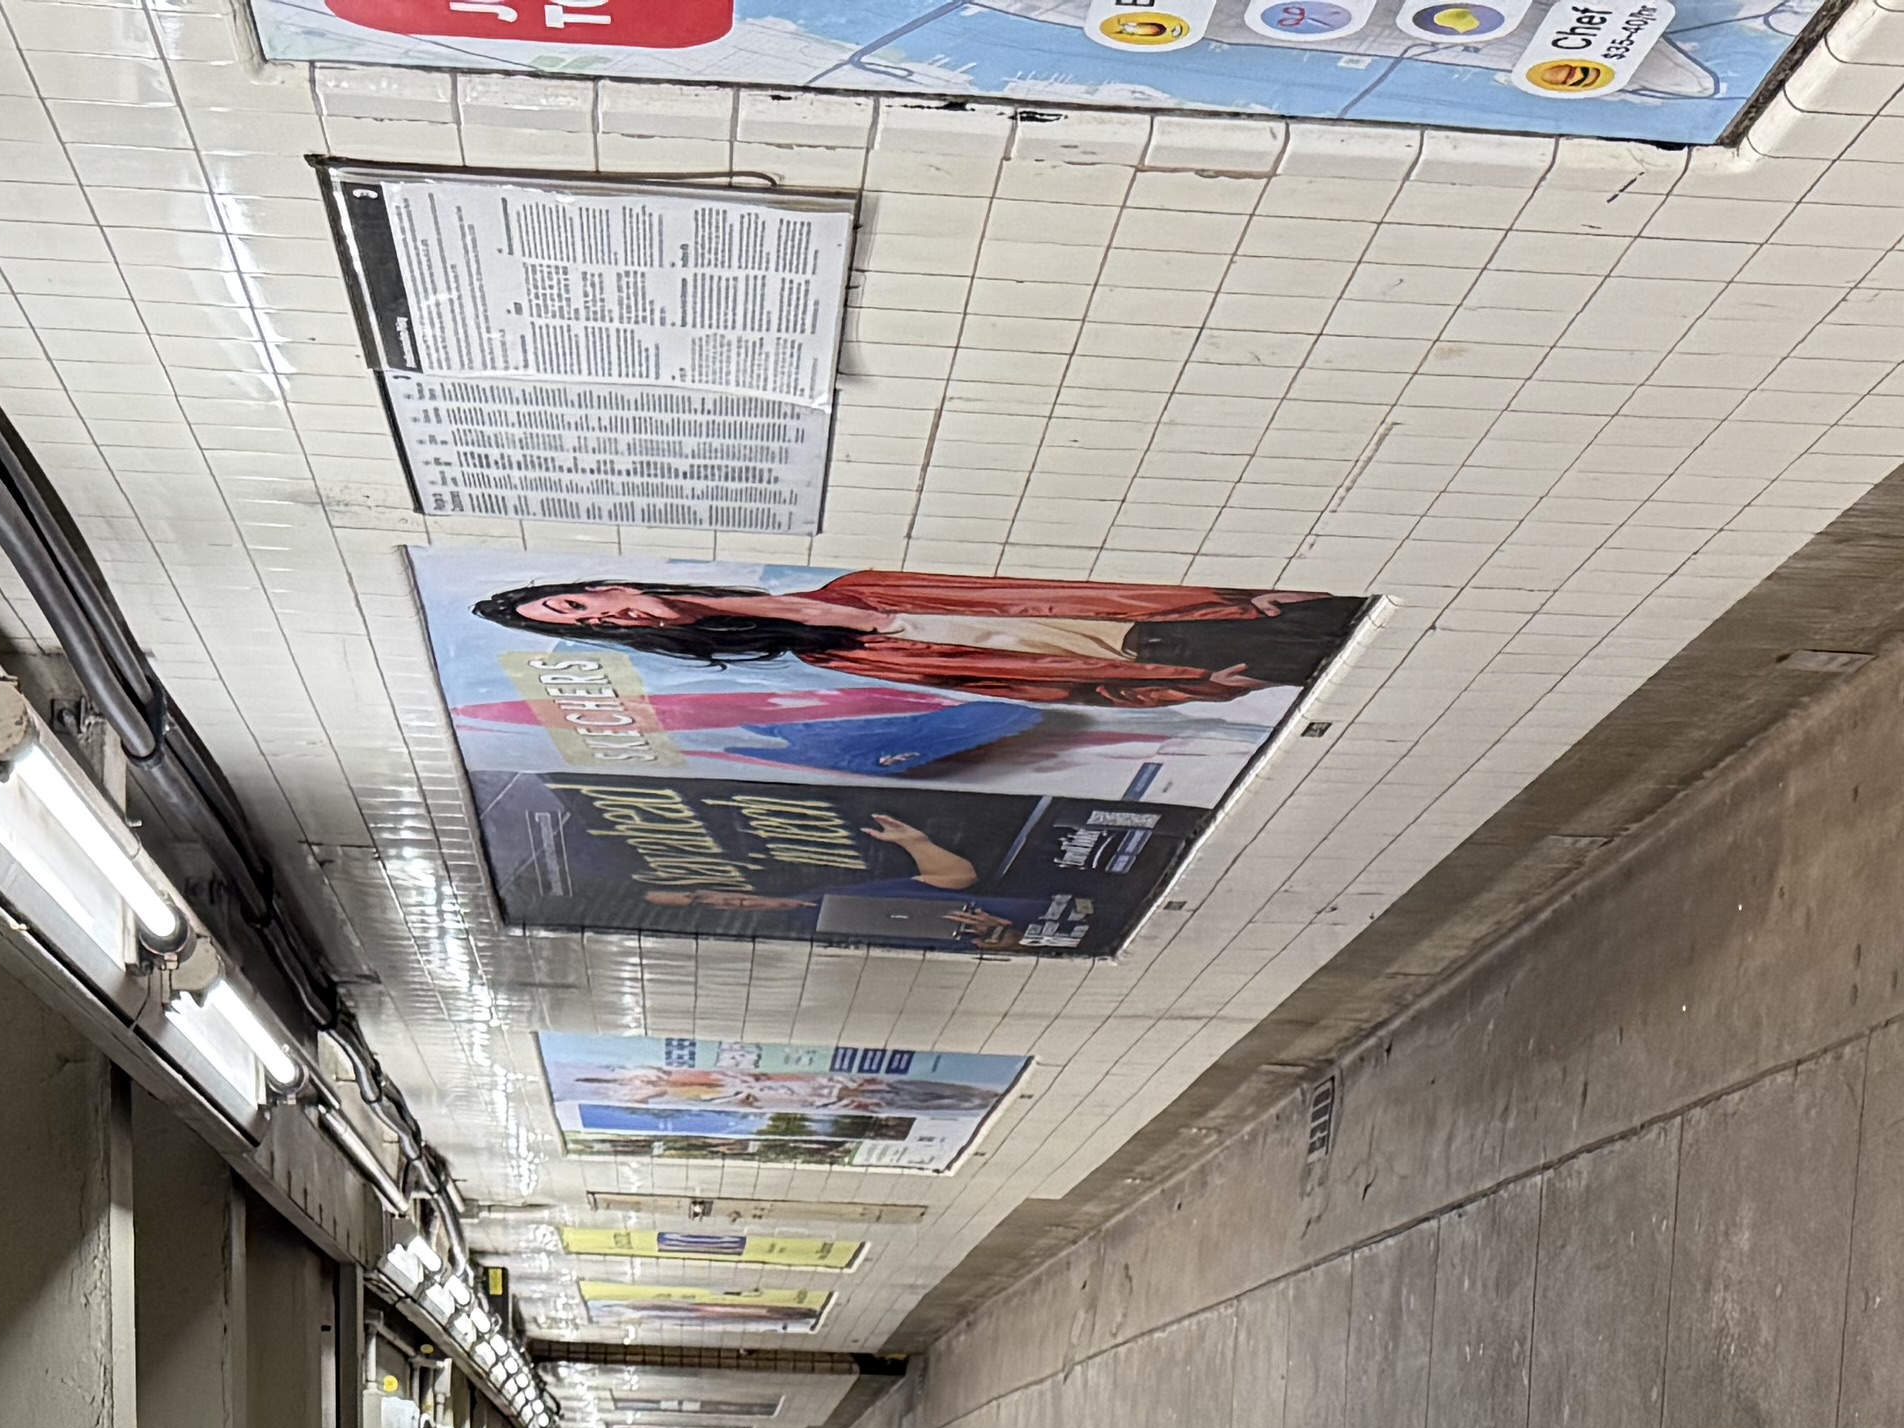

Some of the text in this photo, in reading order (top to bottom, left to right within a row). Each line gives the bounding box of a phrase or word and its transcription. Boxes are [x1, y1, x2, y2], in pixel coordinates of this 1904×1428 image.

[448, 0, 519, 23] J
[1550, 5, 1613, 50] Chef
[530, 657, 658, 762] SKECHERS
[545, 783, 724, 854] ahead
[701, 794, 869, 870] in tech
[631, 851, 763, 891] Stay
